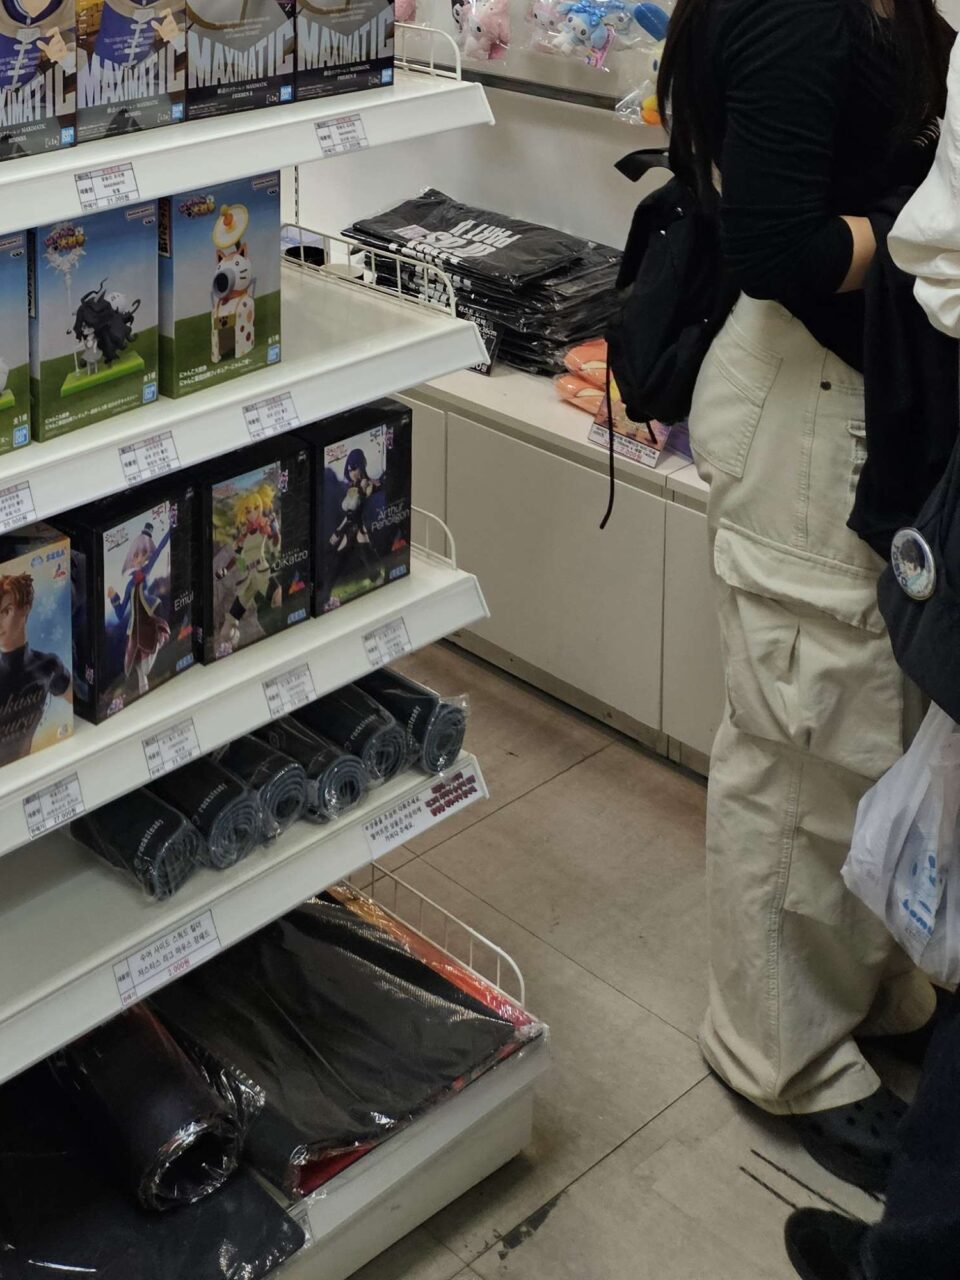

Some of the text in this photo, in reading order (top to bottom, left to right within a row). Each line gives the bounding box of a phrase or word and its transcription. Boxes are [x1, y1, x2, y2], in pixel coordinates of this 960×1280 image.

[187, 17, 294, 89] MAXIMATIC
[297, 3, 394, 71] MAXIMATIC
[77, 47, 186, 109] MAXIMATIC
[468, 223, 522, 249] PART
[46, 549, 66, 563] SEGA
[174, 592, 194, 612] Emul
[137, 931, 211, 977] 저스티스 리그 마우스 장패드
[153, 939, 170, 956] 사이드
